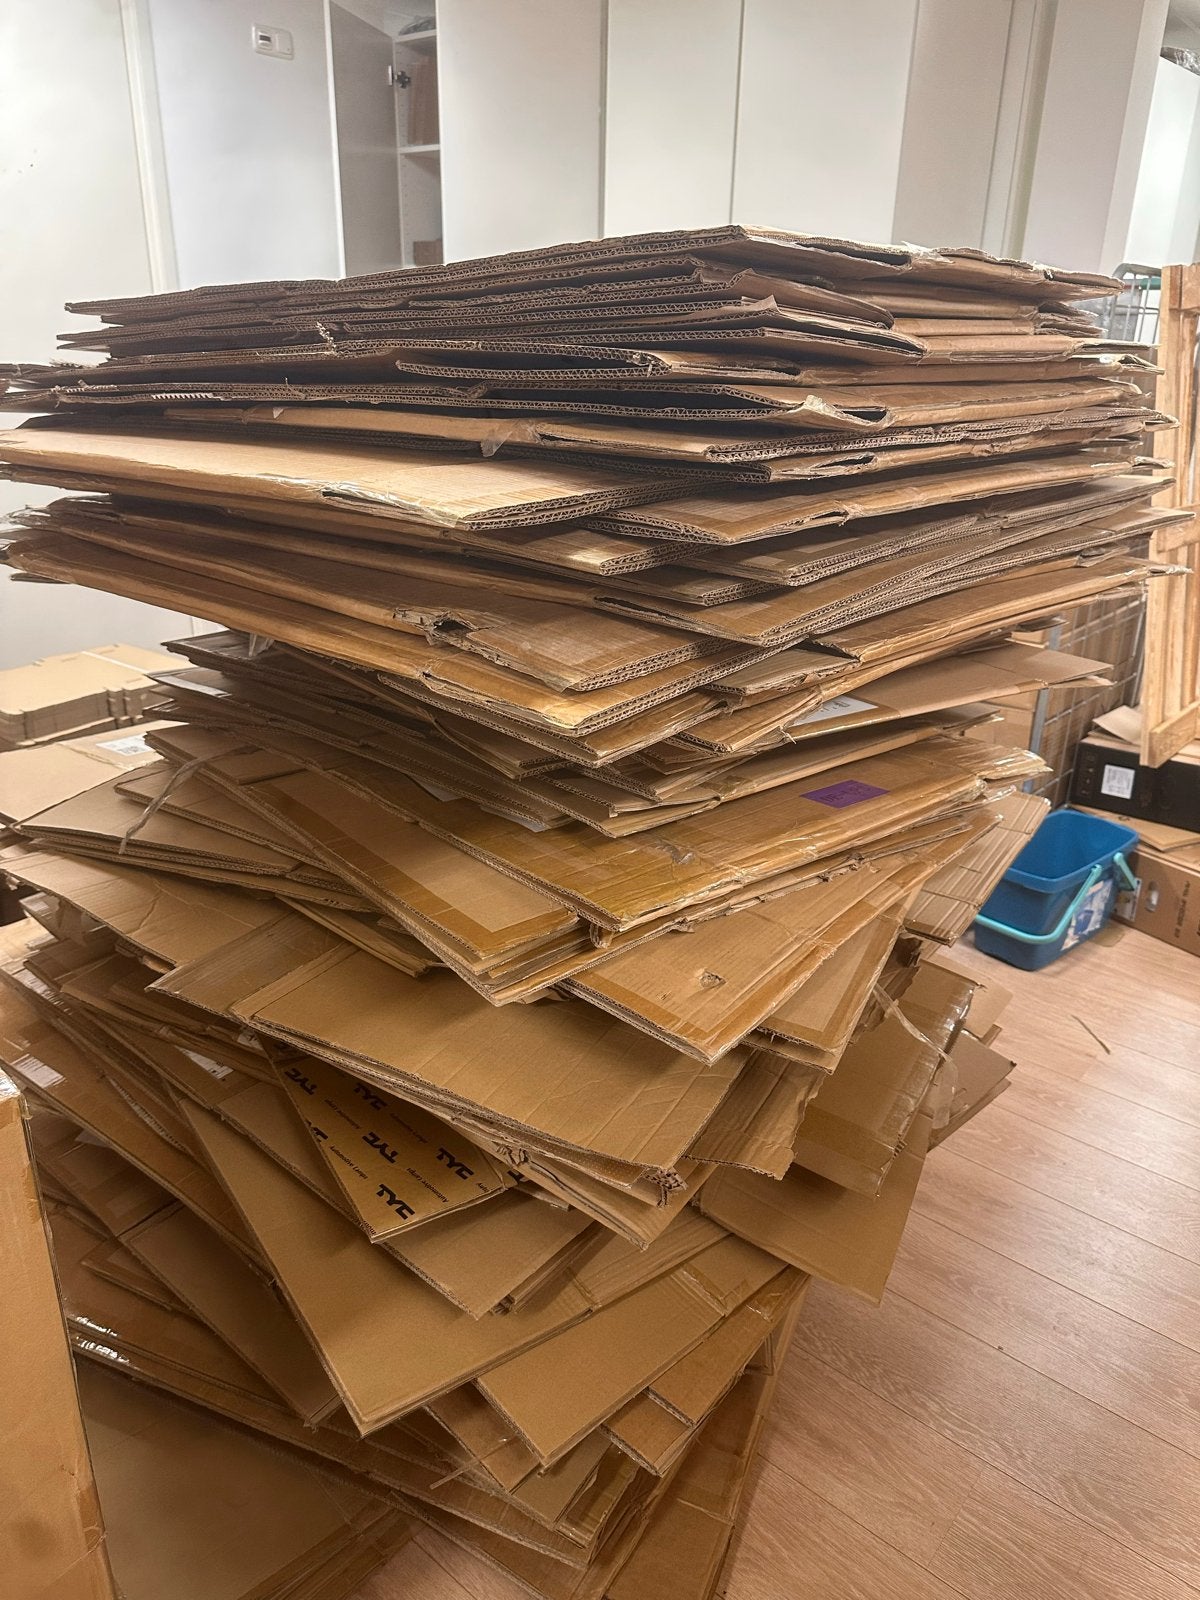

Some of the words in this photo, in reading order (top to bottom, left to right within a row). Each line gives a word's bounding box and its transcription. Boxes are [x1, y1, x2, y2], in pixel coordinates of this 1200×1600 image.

[284, 1067, 318, 1095] TYC
[353, 1082, 388, 1111] TYC
[330, 1145, 354, 1167] Automotive
[352, 1165, 369, 1180] Lamps
[362, 1131, 399, 1164] TYC
[406, 1167, 423, 1181] Lamps
[436, 1147, 475, 1180] TYC
[376, 1183, 416, 1220] TYC
[421, 1180, 449, 1203] Automotive
